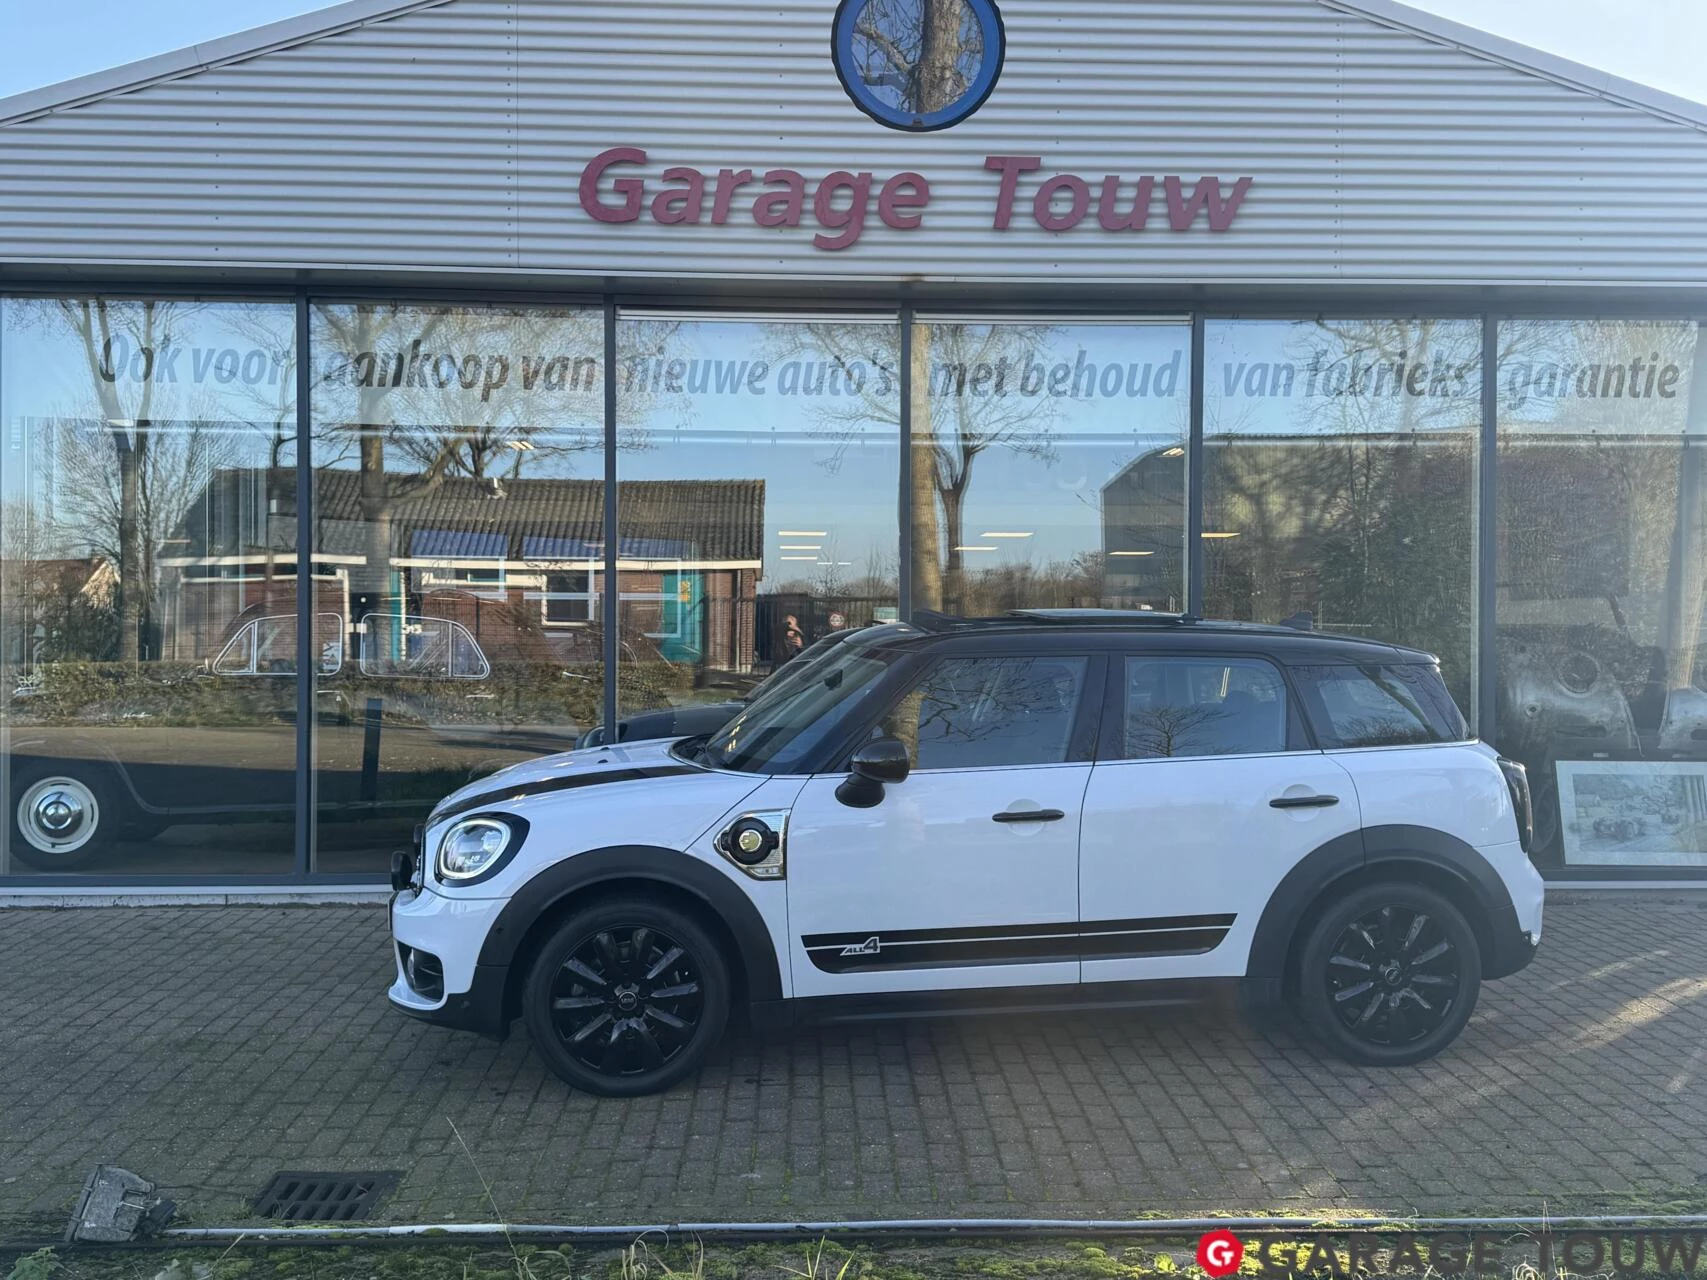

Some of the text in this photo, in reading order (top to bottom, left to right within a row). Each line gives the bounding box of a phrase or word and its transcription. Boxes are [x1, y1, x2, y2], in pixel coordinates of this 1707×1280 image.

[579, 147, 1253, 250] Garage Touw
[99, 333, 1680, 410] Ook voor aankoop van nieuwe auto's met behoud van fabrieks garantie
[842, 936, 880, 955] ALL4
